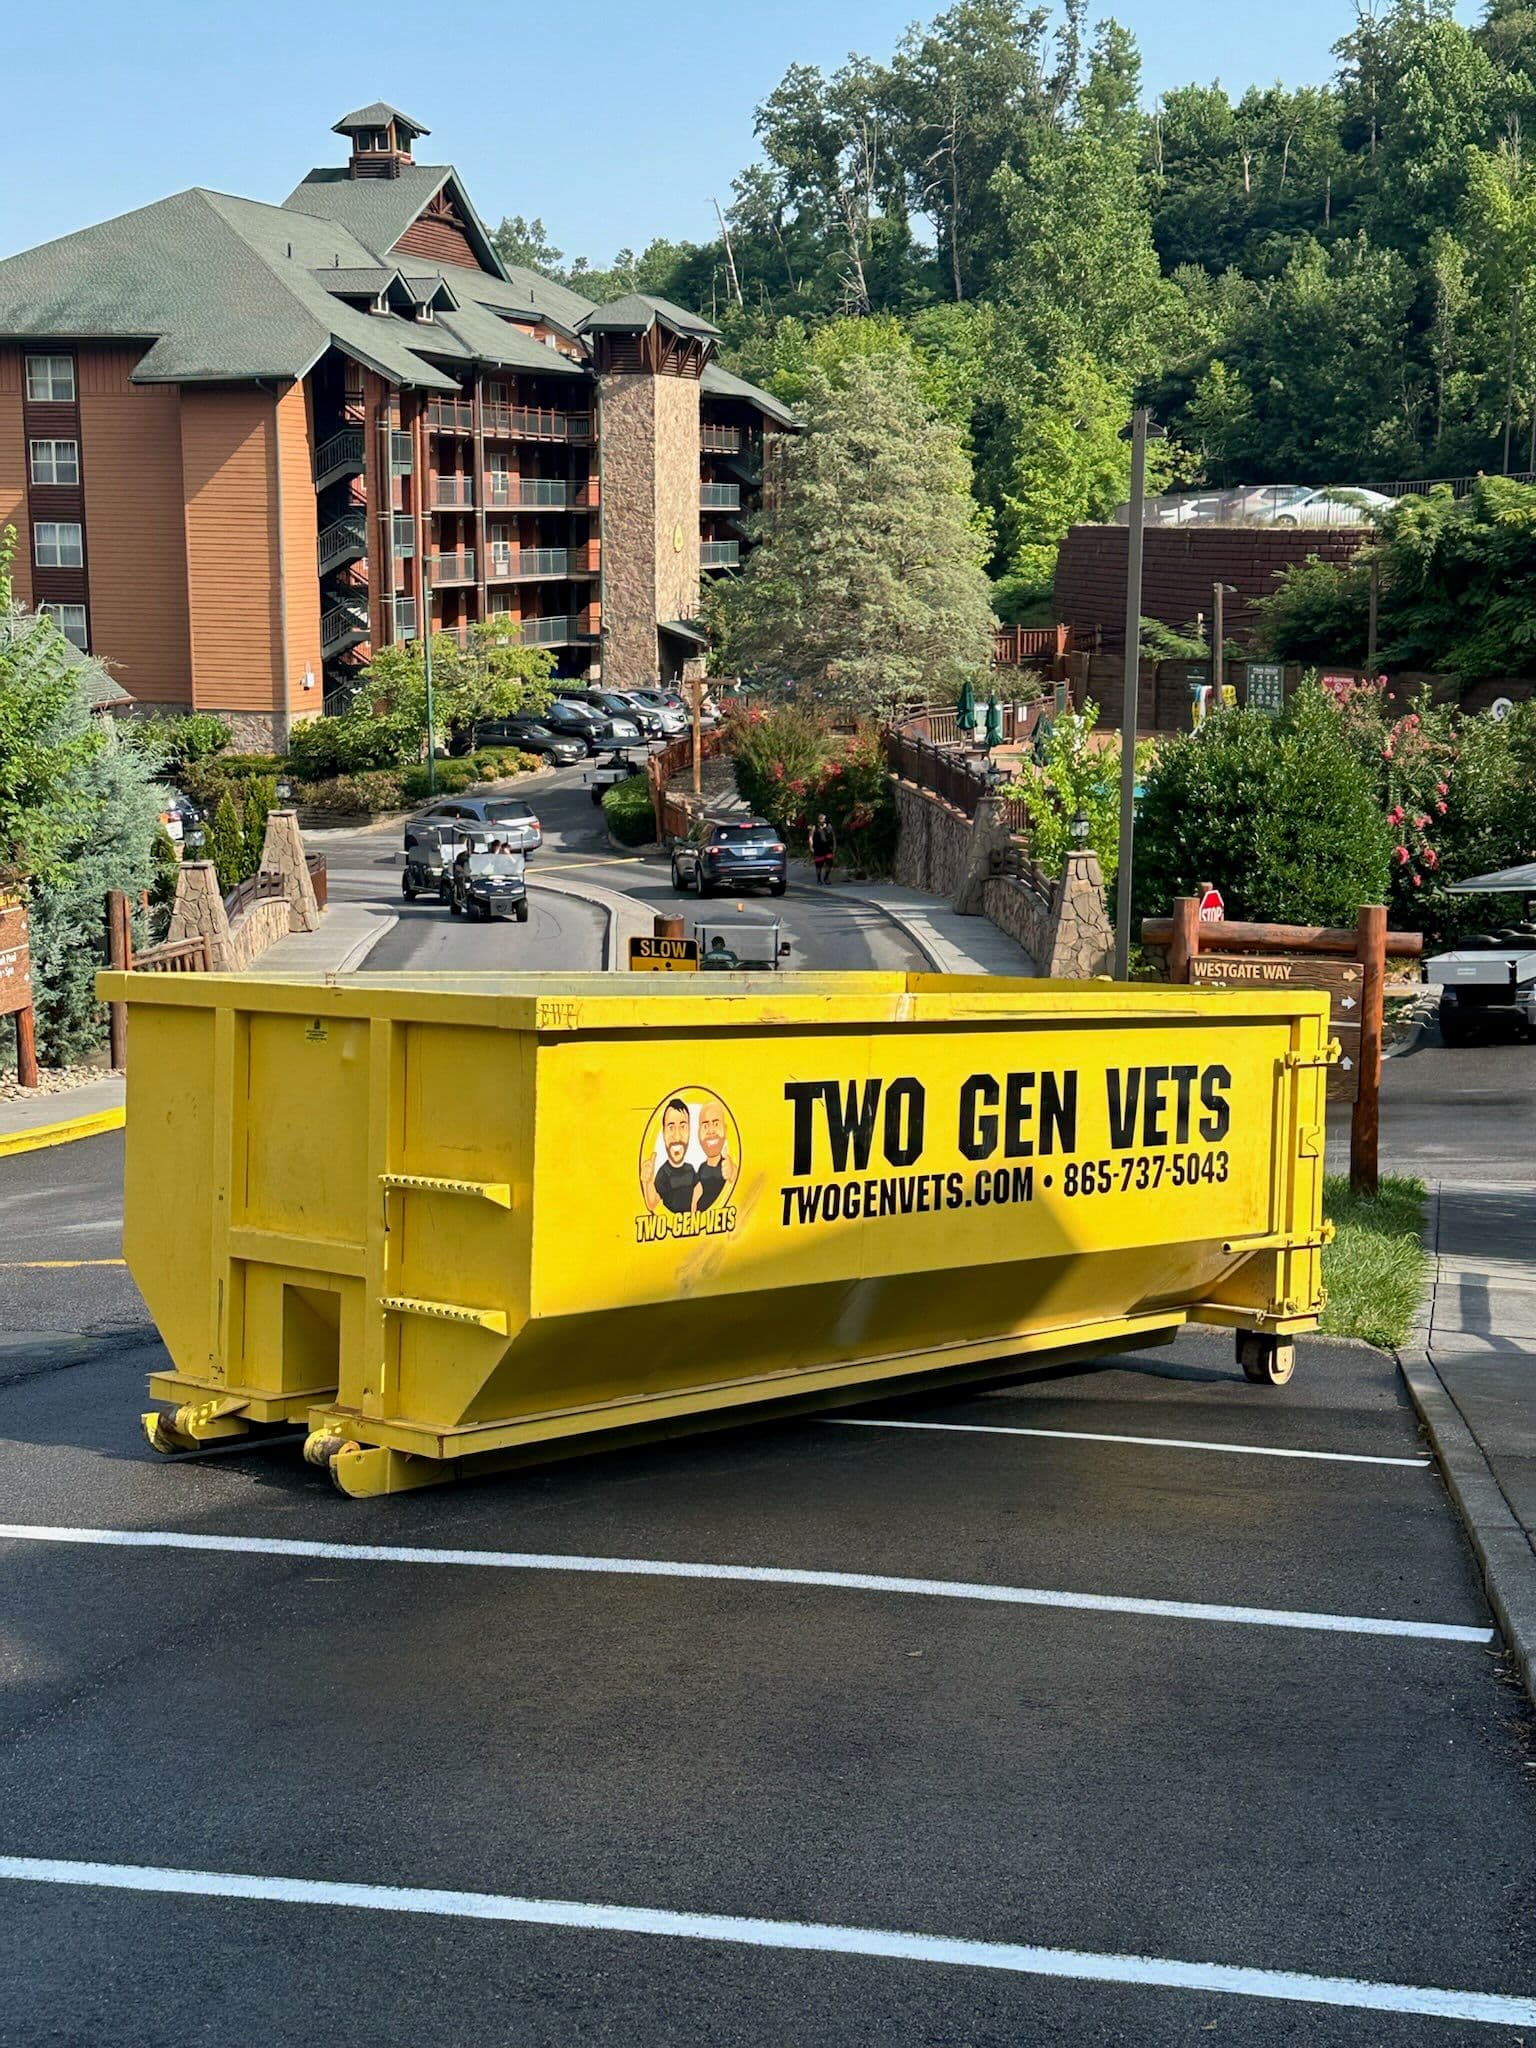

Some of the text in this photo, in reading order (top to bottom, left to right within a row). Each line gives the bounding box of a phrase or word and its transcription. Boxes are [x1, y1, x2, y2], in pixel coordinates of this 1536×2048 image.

[640, 940, 687, 958] SLOW
[1194, 962, 1292, 980] WESTGATE WAY
[784, 1064, 1232, 1176] TWO GEN VETS
[781, 1151, 1229, 1226] TWOGENVETS.COM 865-737-5043
[635, 1206, 737, 1242] TWO GEN VETS
